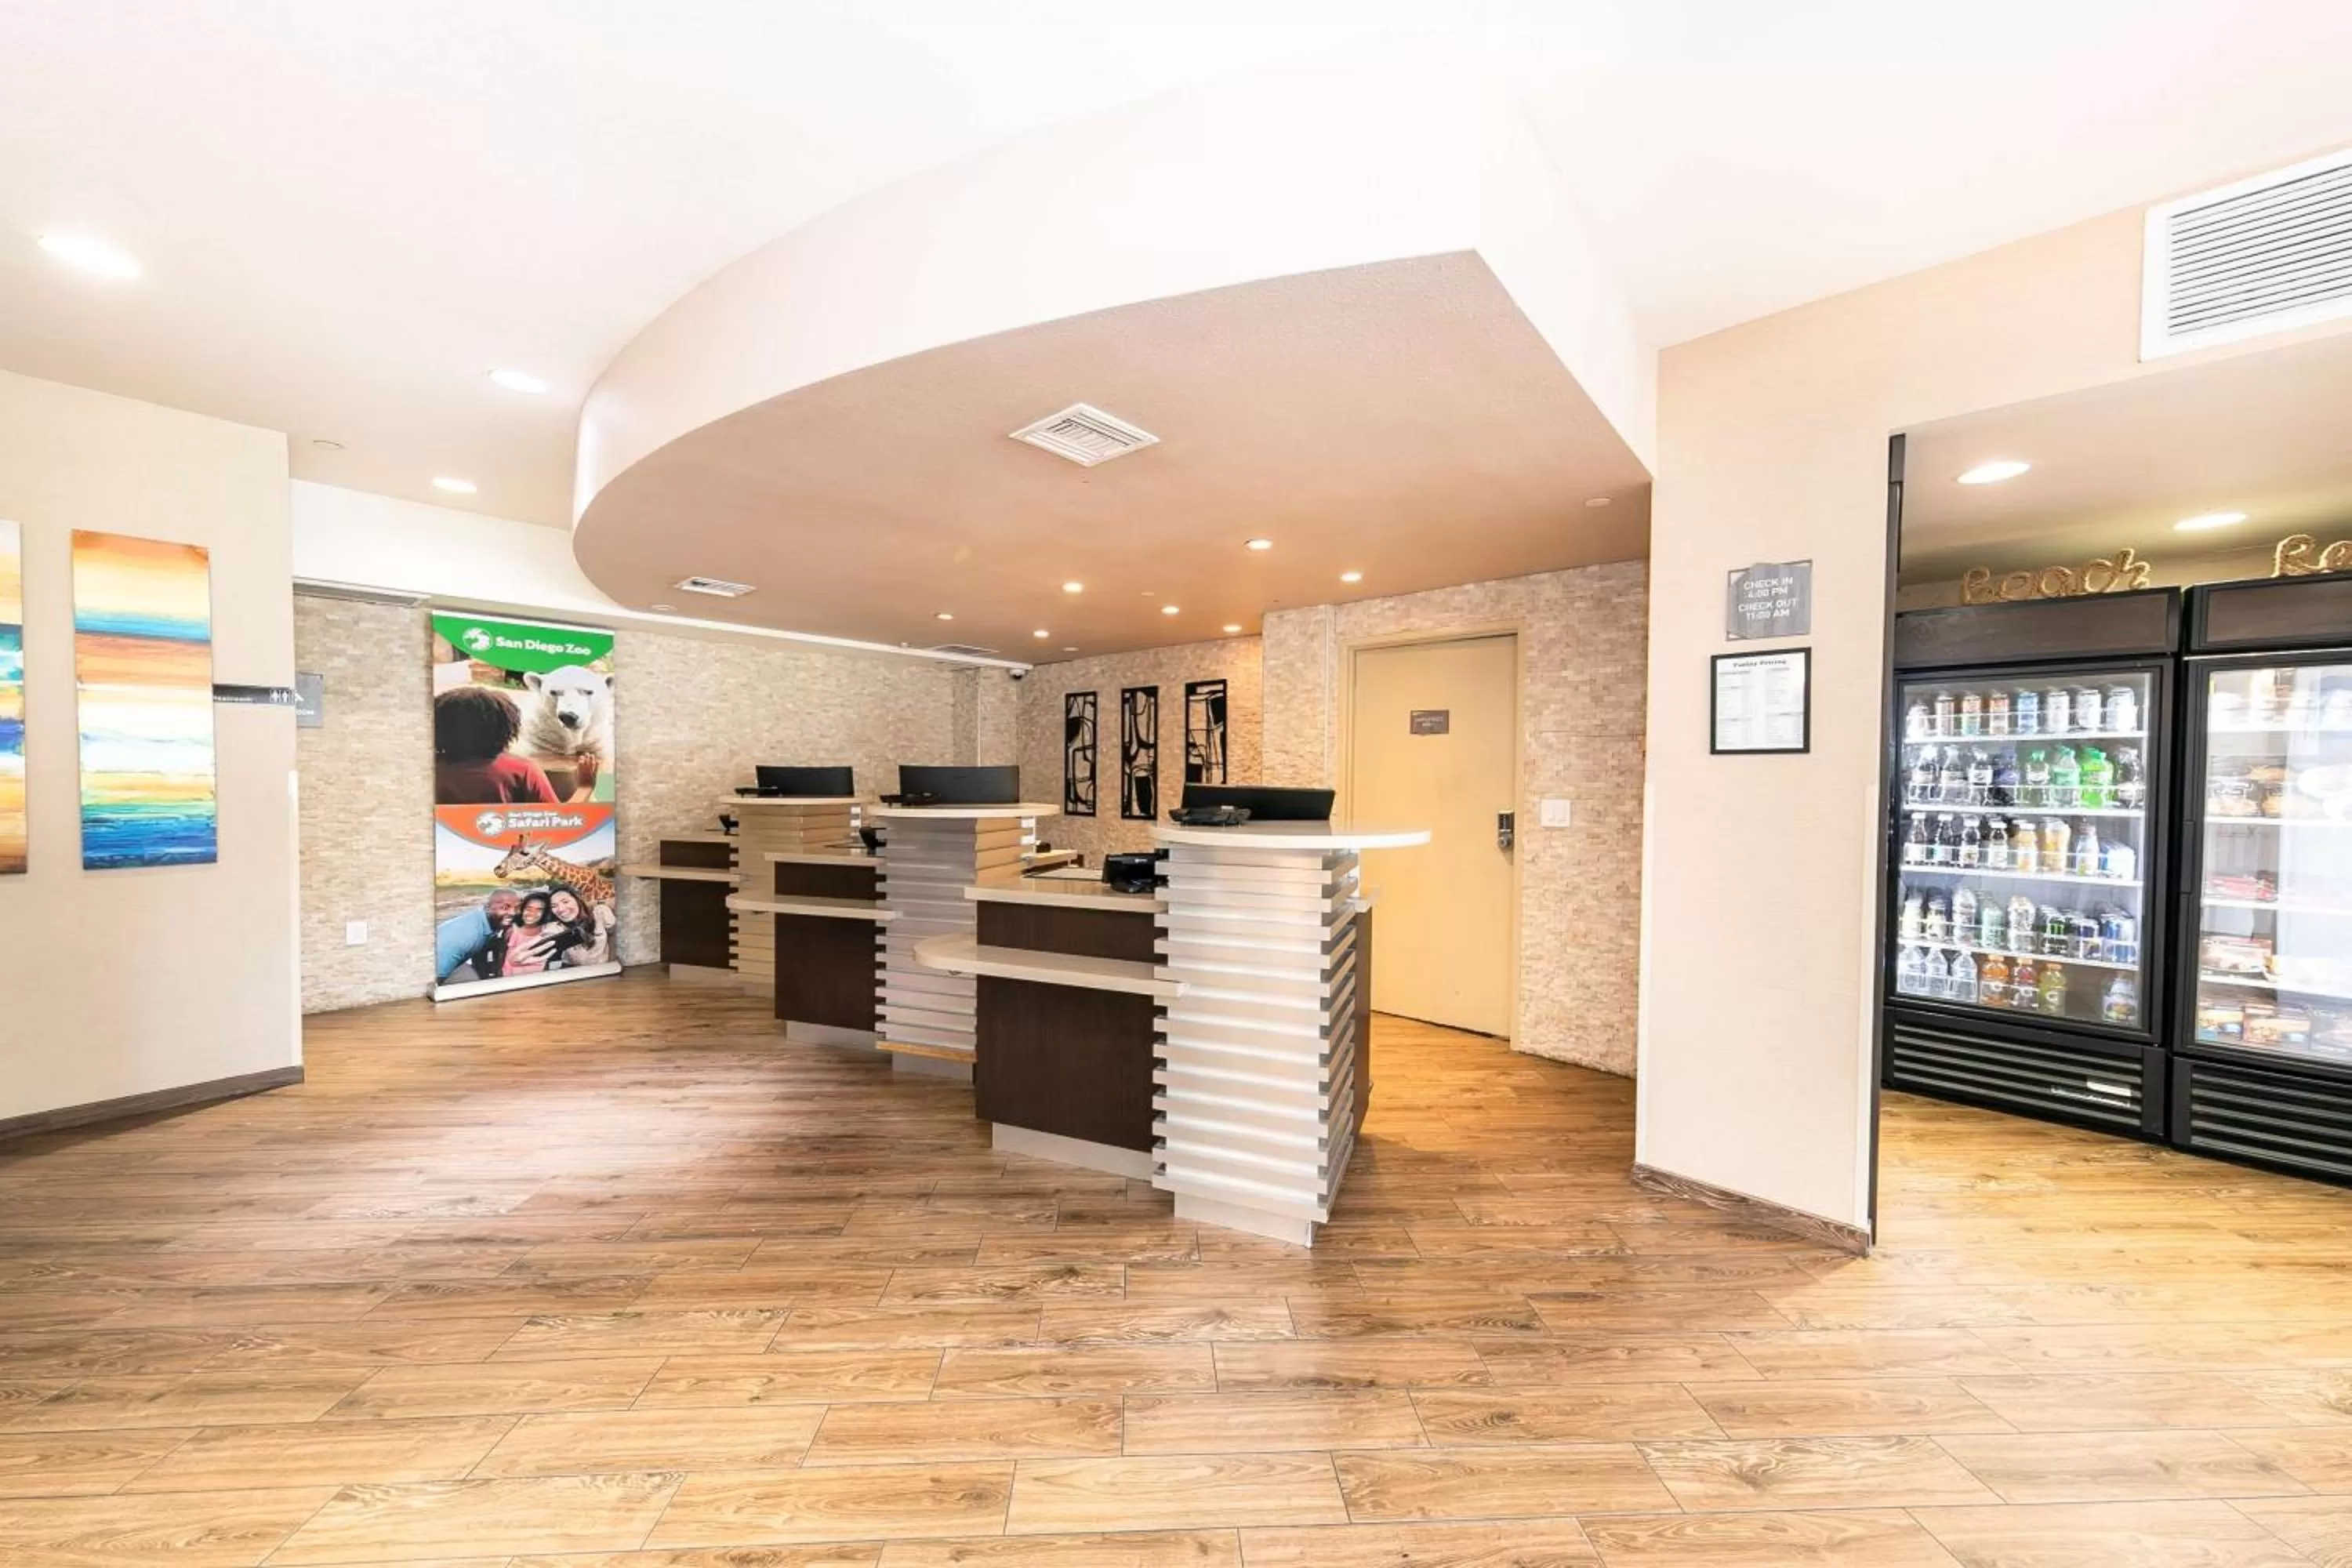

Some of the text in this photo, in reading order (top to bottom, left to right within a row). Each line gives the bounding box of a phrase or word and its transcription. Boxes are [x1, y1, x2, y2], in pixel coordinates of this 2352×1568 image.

[1744, 576, 1793, 590] CHECK IN
[1771, 586, 1788, 596] PM
[1738, 597, 1799, 612] CHECK OUT
[1773, 608, 1790, 618] AM
[495, 636, 592, 655] San Diego Zoo
[508, 816, 584, 829] Safari Park
